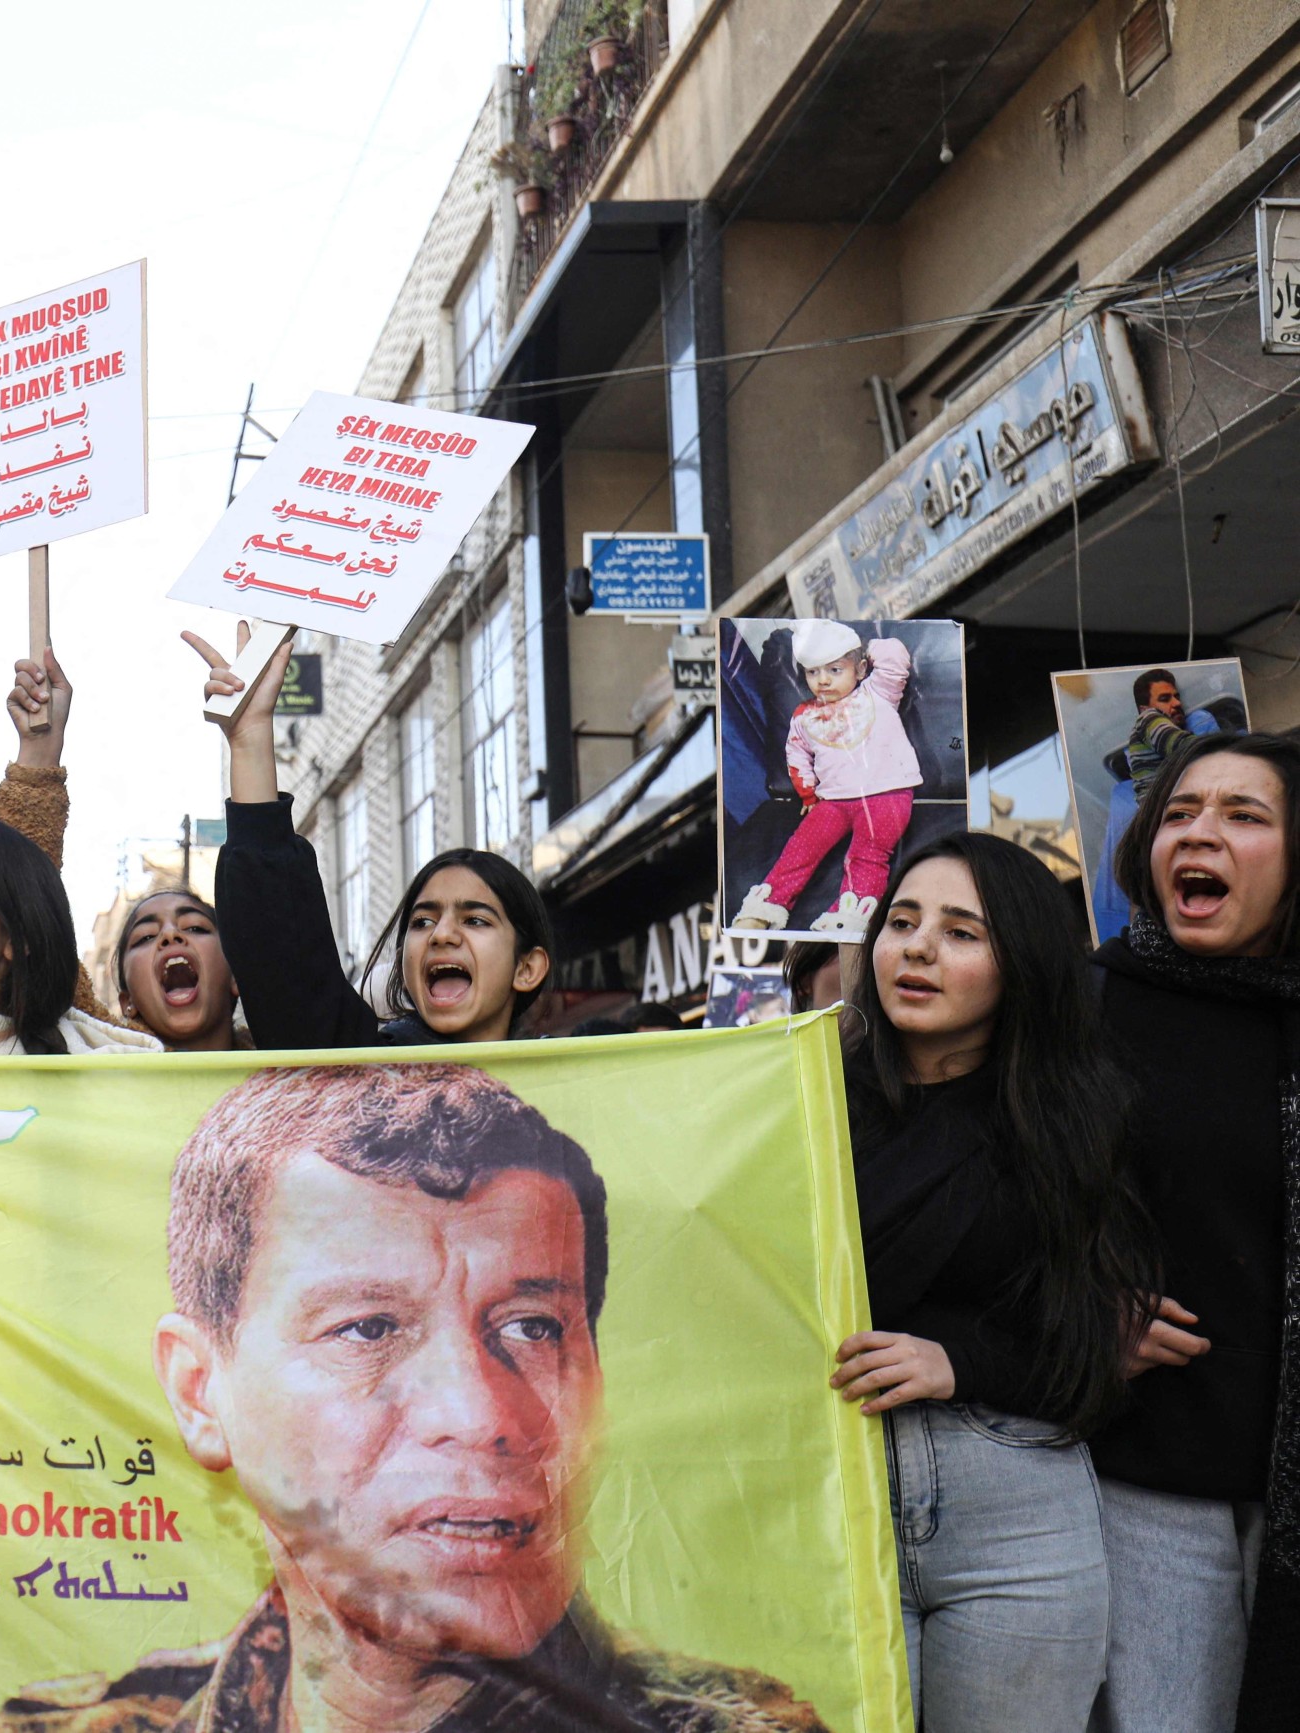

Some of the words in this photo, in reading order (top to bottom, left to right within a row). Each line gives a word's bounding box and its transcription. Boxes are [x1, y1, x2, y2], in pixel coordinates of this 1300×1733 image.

[11, 288, 108, 338] MUQSUD
[15, 325, 88, 371] XWÎNÊ
[70, 351, 123, 388] TENE
[337, 416, 381, 437] ŞÊX
[380, 424, 477, 457] MEQSÛD
[344, 446, 370, 464] BI
[374, 451, 430, 478] TERA
[49, 475, 89, 515] شيخ
[299, 468, 356, 491] HEYA
[356, 477, 441, 511] MIRINE
[272, 499, 370, 530] مقصود
[370, 514, 422, 542] شيخ
[243, 532, 346, 564] معكم
[345, 550, 397, 575] نحن
[223, 562, 376, 610] للموت
[45, 1436, 155, 1485] قوات
